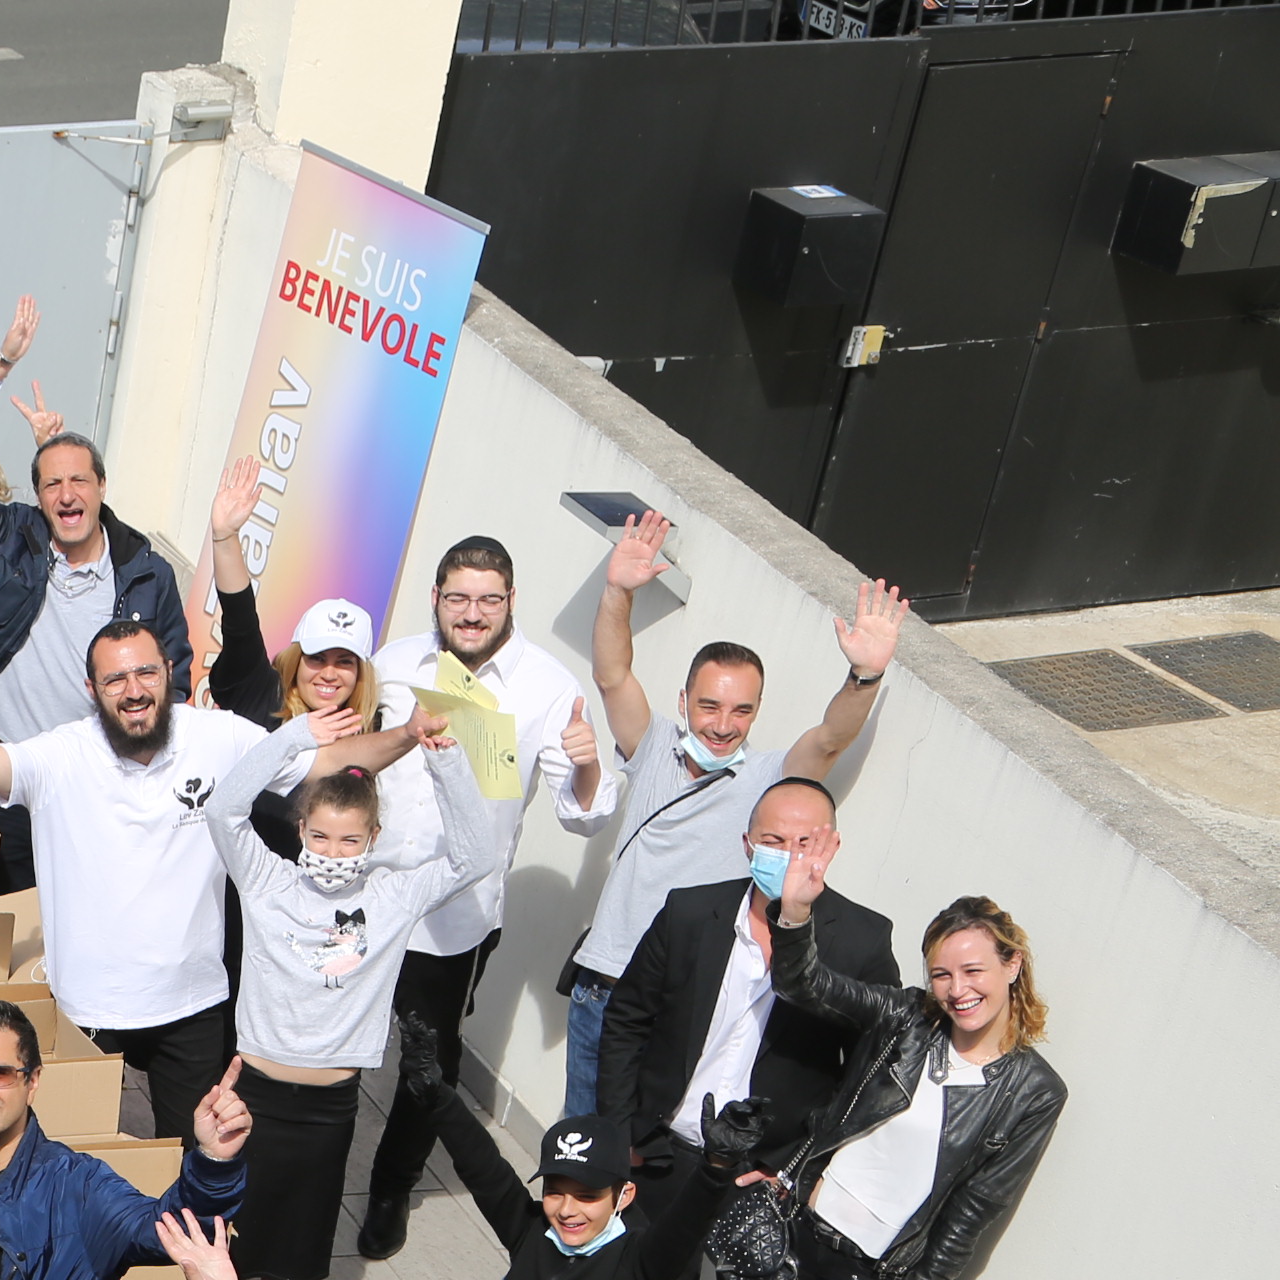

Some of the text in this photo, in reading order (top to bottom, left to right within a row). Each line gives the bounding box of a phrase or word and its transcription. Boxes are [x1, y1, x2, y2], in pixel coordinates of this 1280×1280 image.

[279, 260, 446, 378] BENEVOLE
[316, 228, 427, 311] JE SUIS
